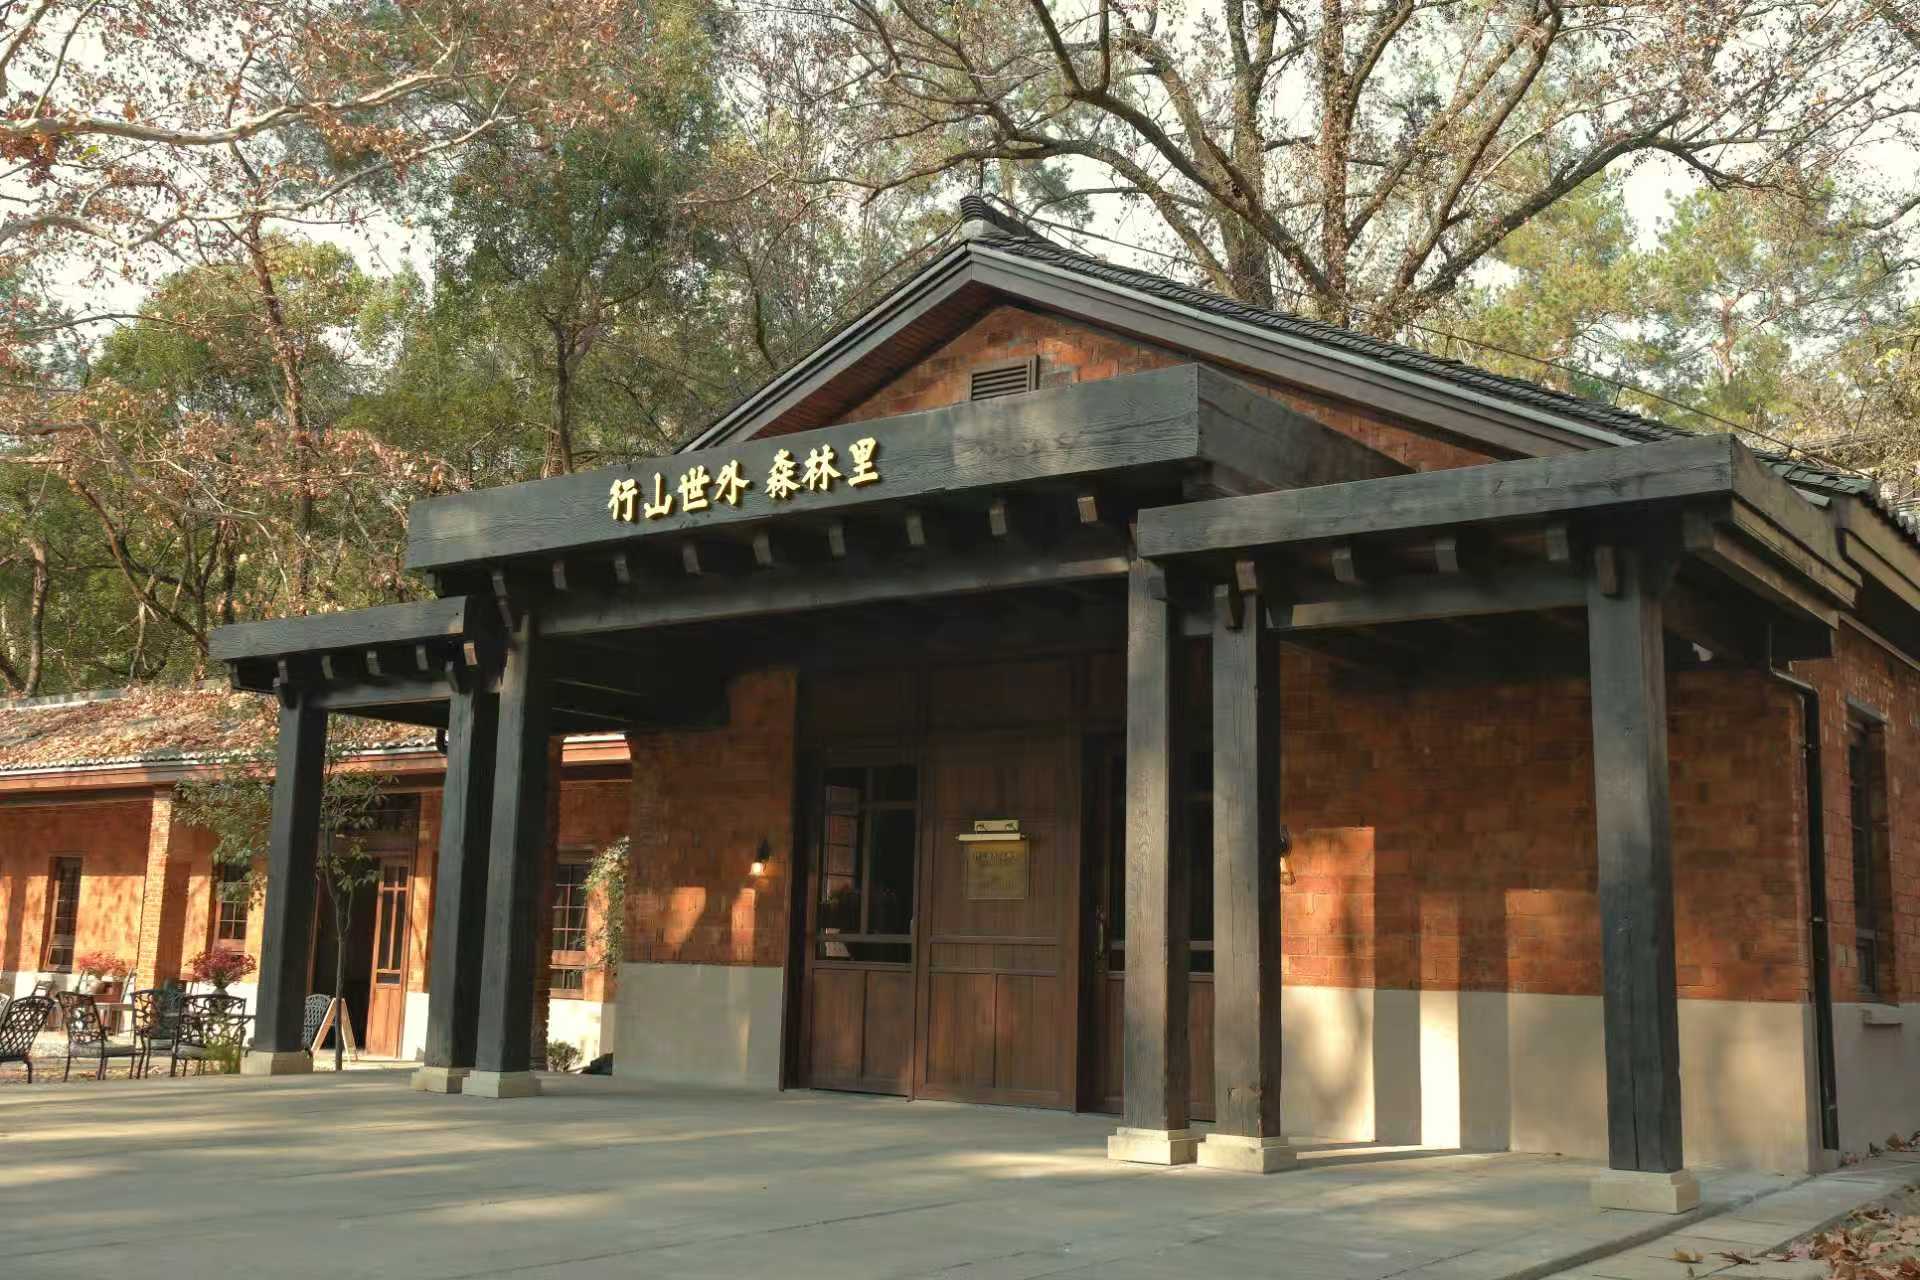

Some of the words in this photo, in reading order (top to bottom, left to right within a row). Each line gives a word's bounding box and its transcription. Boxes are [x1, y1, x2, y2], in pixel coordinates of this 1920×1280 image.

[607, 461, 750, 522] 行山世外
[765, 437, 880, 499] 森林里
